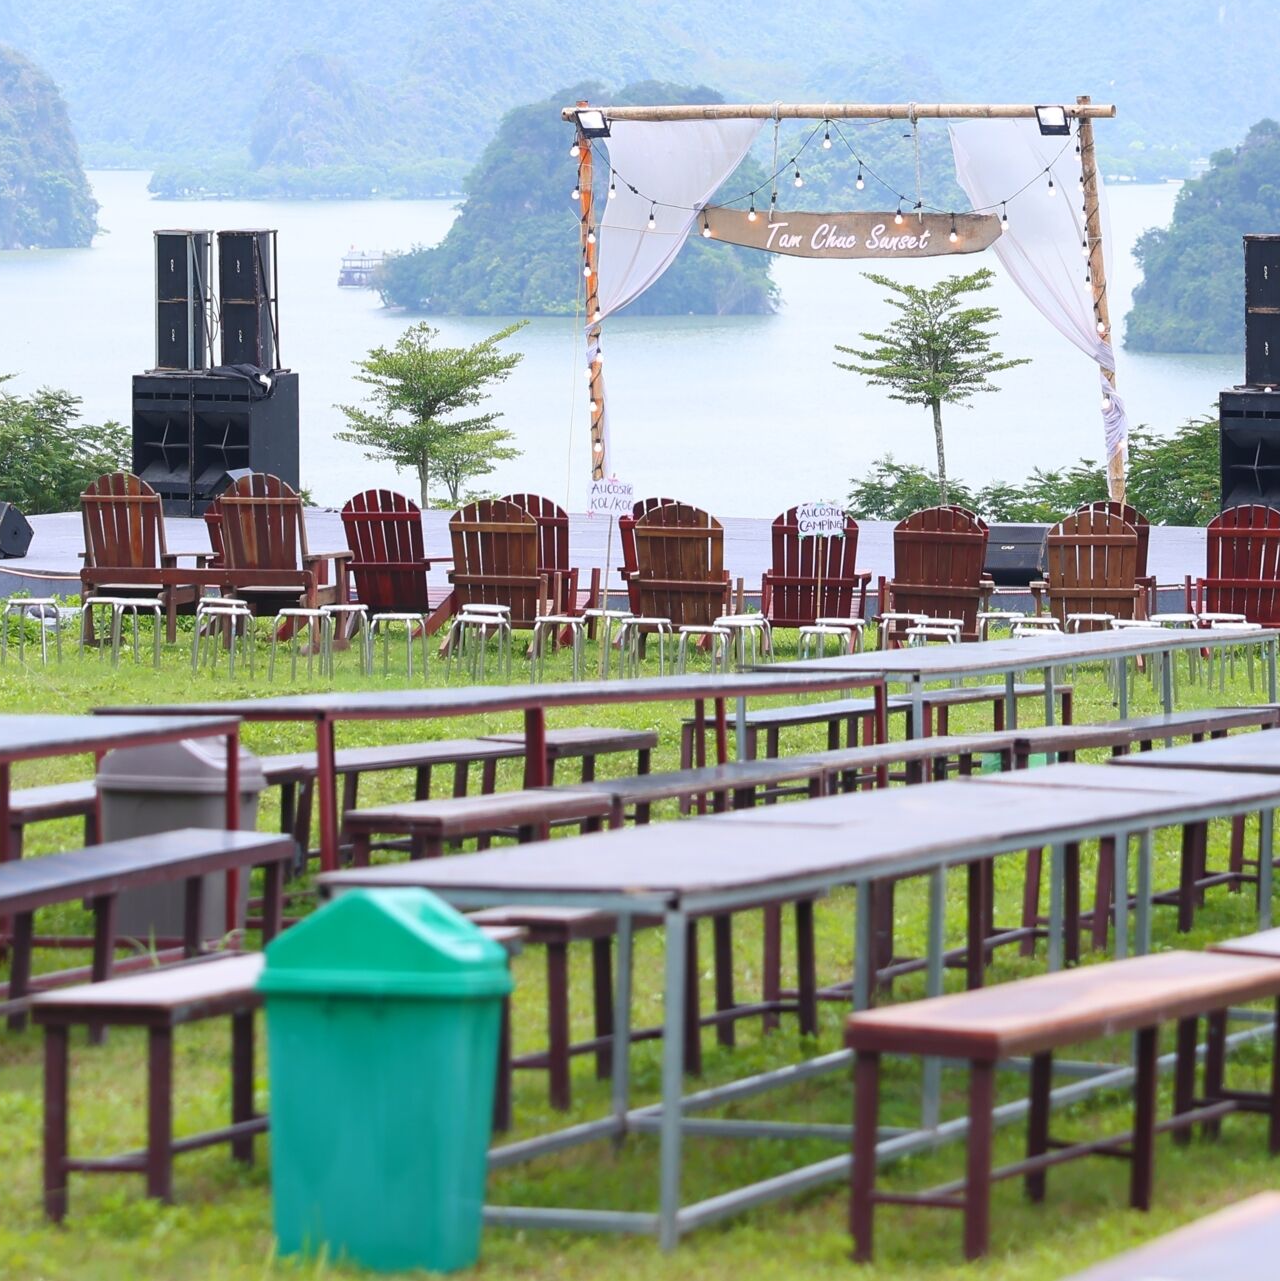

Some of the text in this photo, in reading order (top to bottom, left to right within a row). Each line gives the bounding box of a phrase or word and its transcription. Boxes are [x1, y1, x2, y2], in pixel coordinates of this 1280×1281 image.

[767, 223, 931, 251] Tam Chuc Sunset
[800, 519, 843, 532] CAMPING
